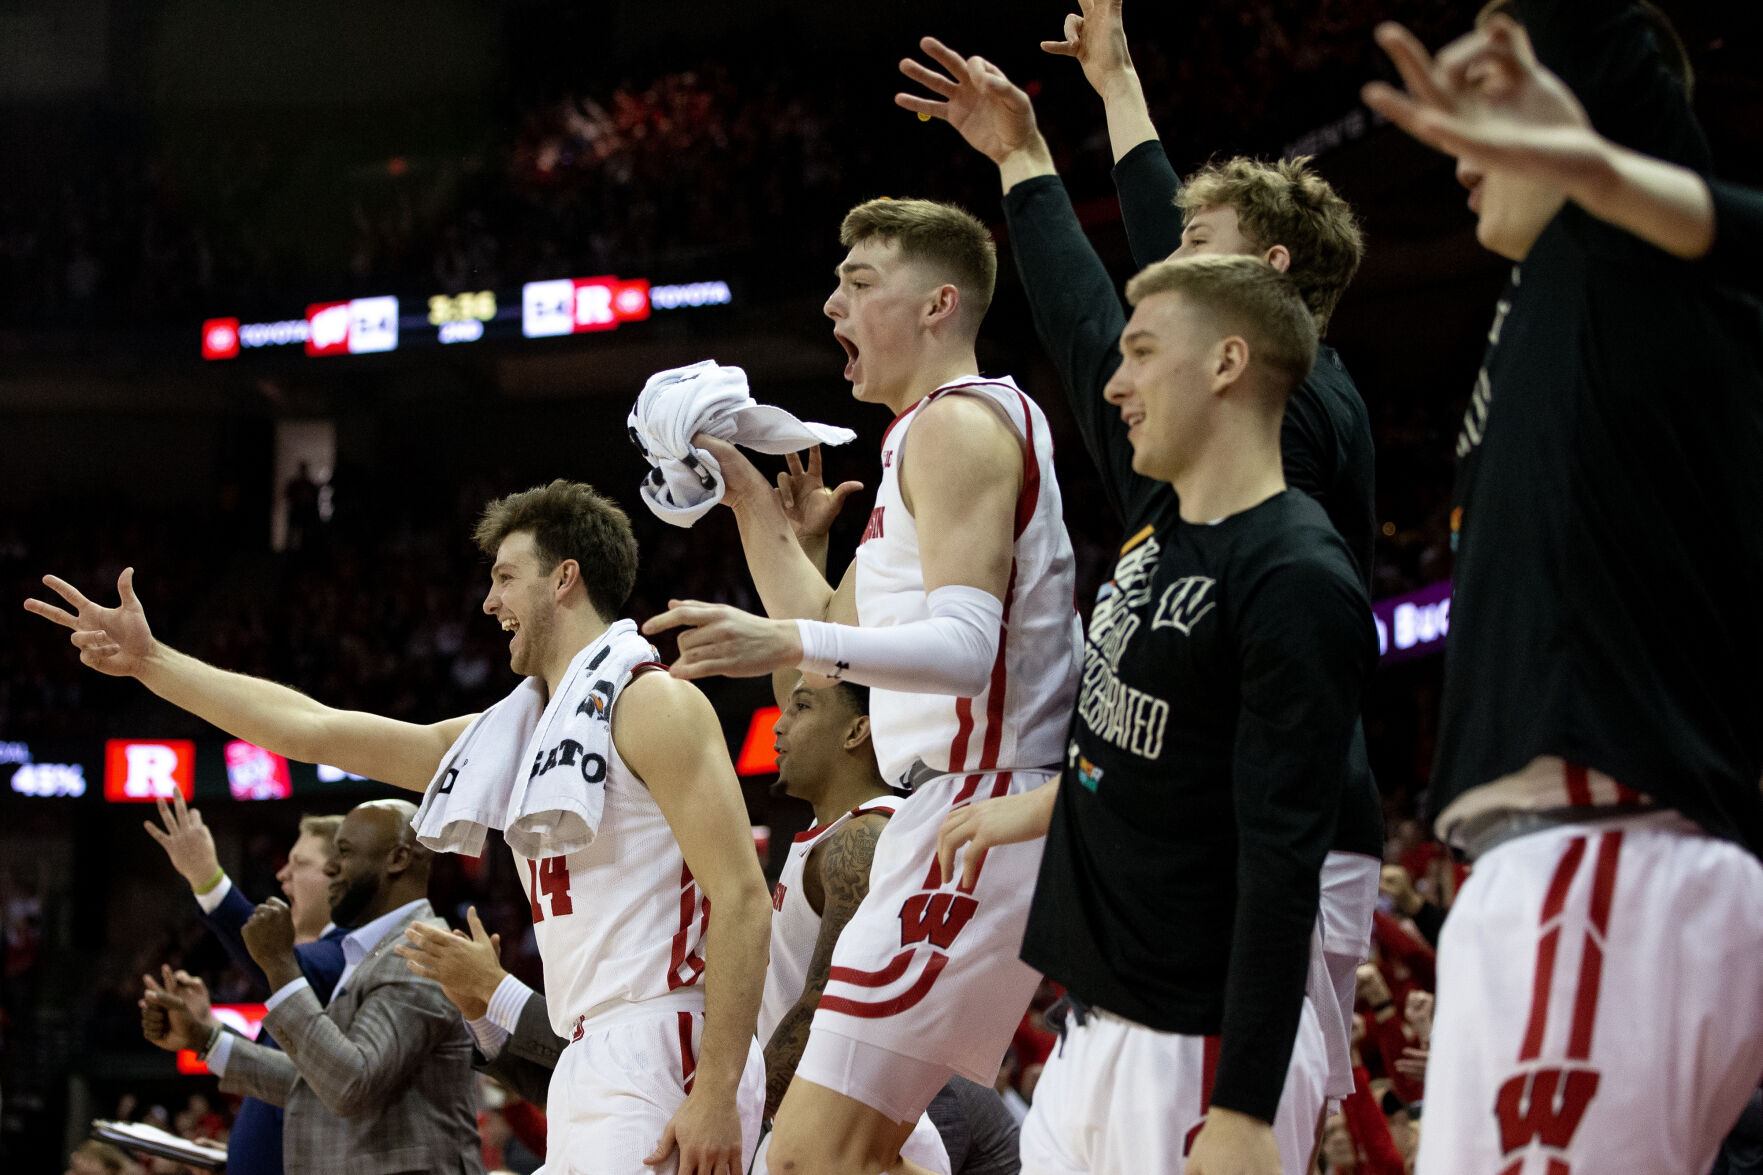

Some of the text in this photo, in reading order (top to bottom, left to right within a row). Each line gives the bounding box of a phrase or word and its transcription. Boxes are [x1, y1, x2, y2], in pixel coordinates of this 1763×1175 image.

[651, 281, 730, 309] TOYOTA
[124, 743, 179, 799] R
[526, 854, 574, 924] 14
[898, 892, 980, 950] W
[1493, 1067, 1602, 1158] W
